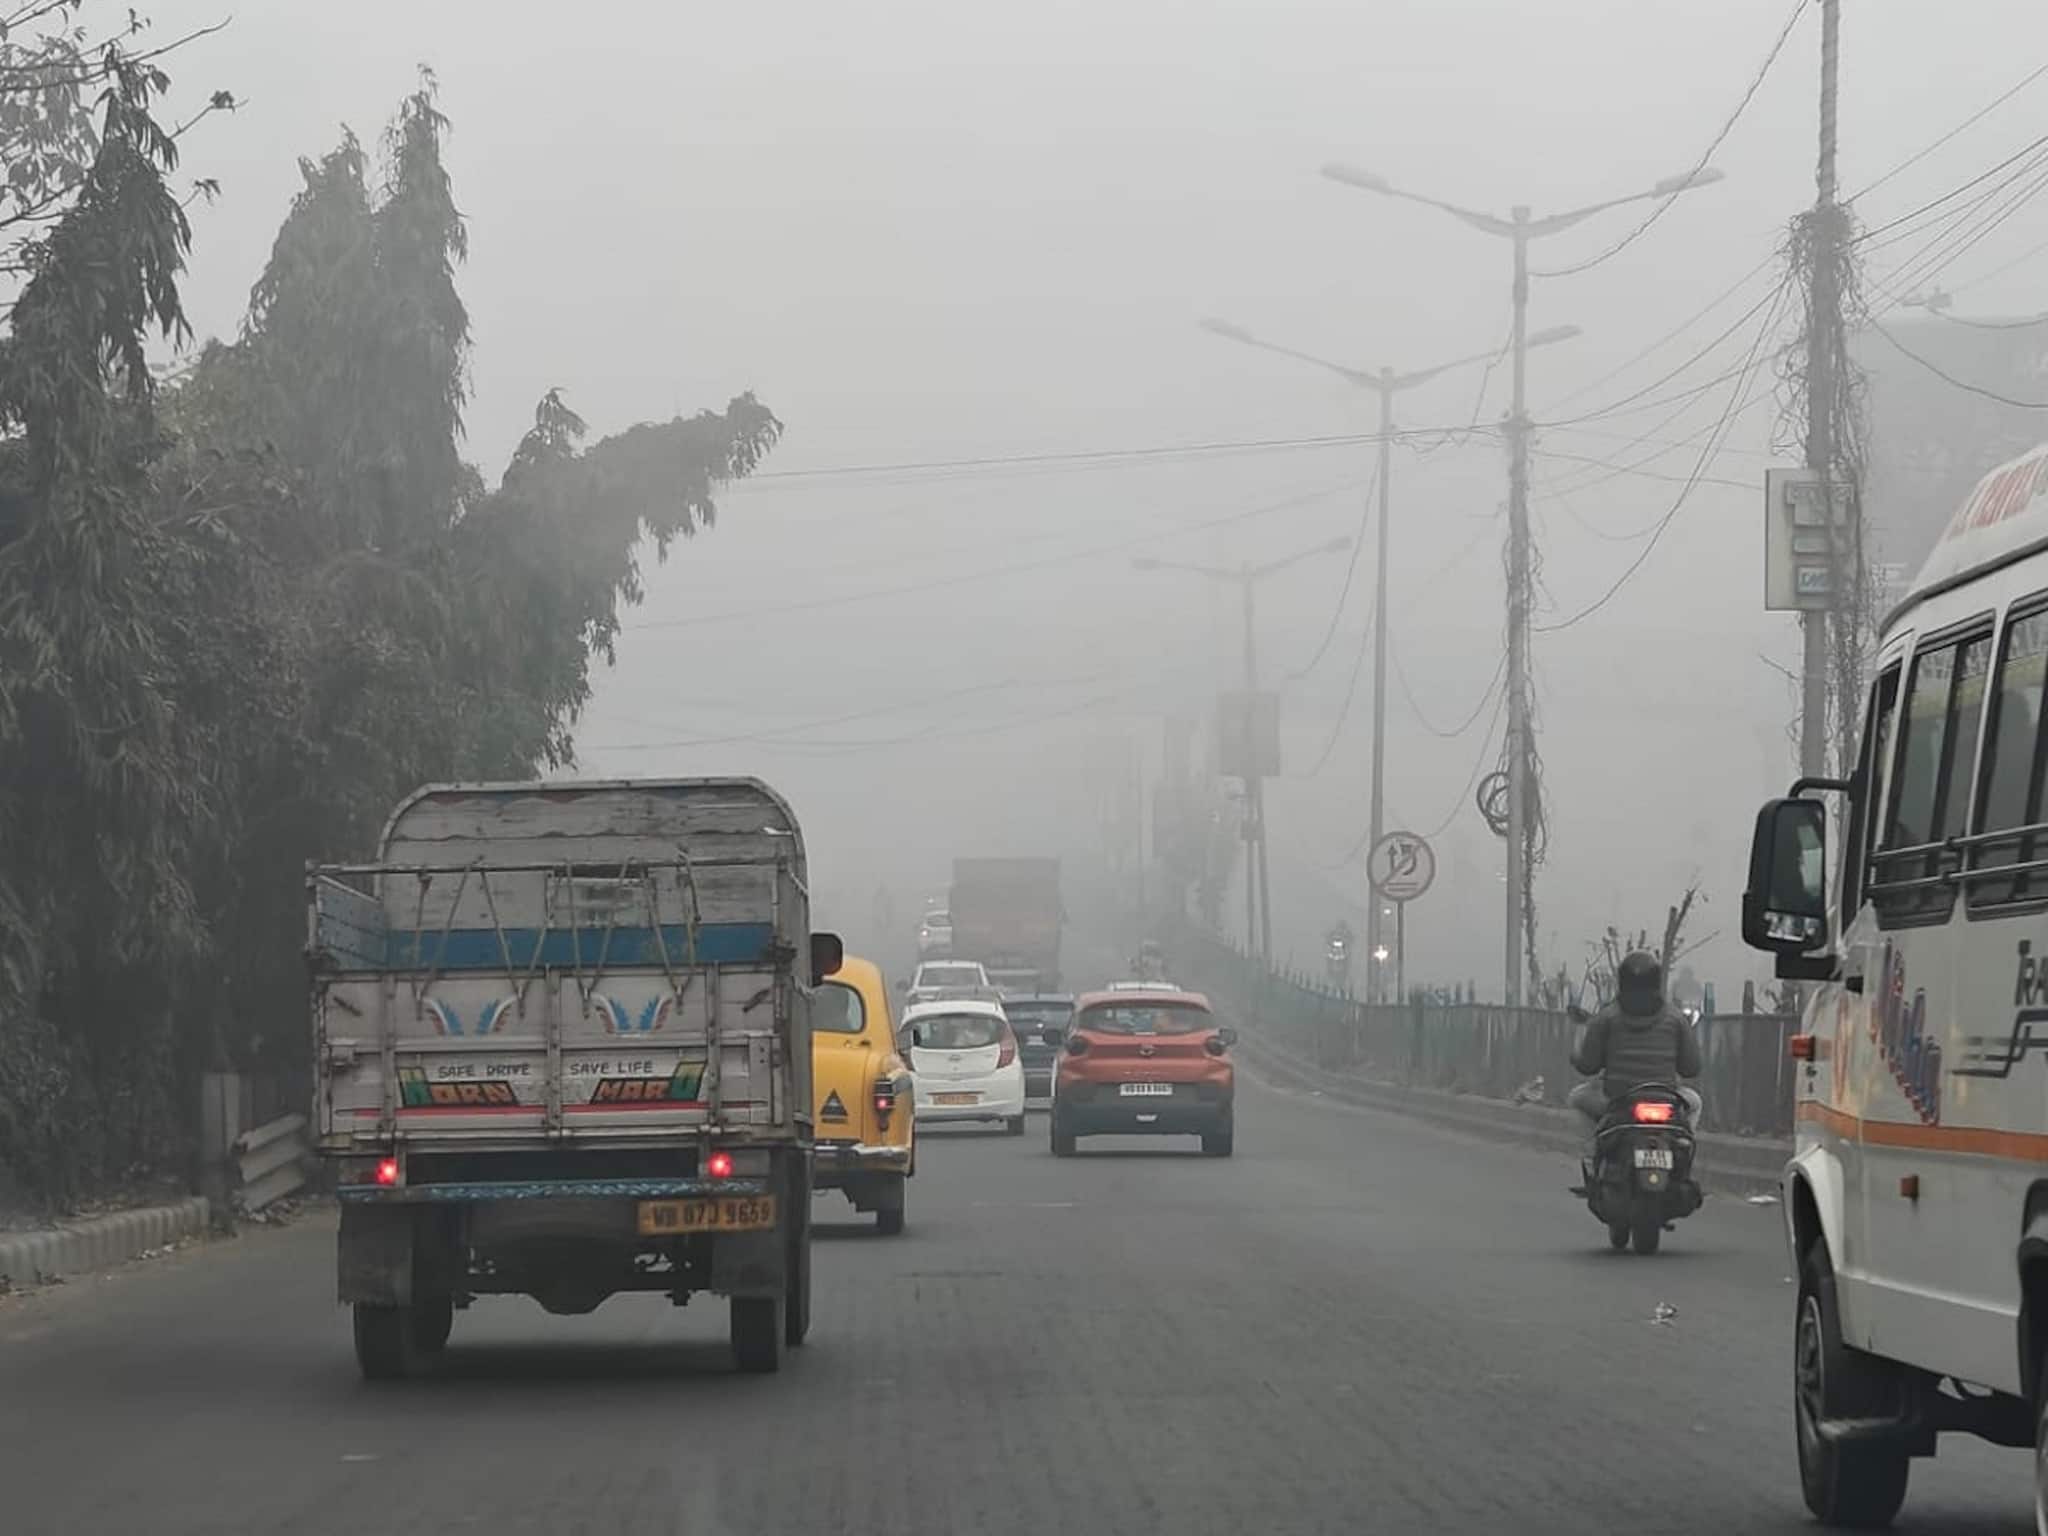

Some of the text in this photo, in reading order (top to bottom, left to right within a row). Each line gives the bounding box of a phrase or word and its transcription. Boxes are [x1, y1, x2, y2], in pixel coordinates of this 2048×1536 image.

[437, 1060, 653, 1079] SAFE DRIVE SAVE LIFE
